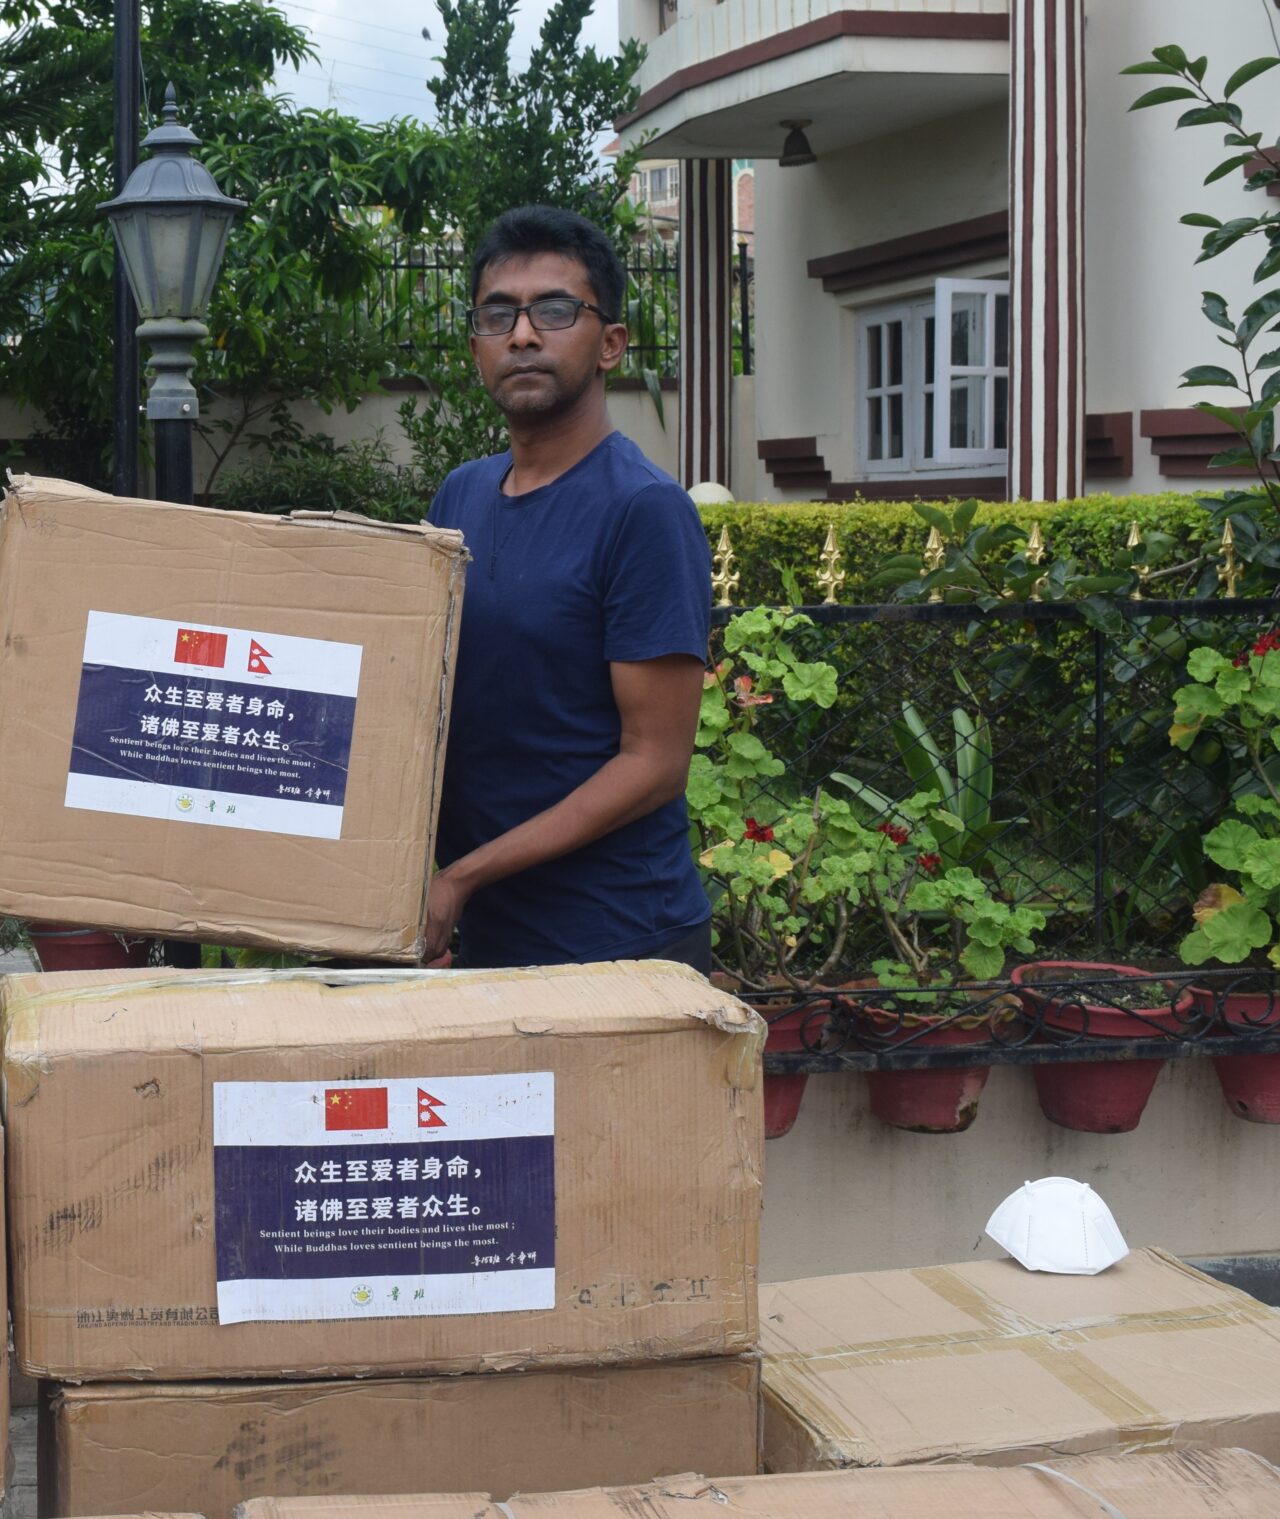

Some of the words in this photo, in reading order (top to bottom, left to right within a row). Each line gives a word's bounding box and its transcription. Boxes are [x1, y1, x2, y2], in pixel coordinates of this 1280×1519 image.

[144, 683, 294, 722] 众生至爱者身命，
[140, 714, 290, 751] 诸佛至爱者众生。
[109, 735, 143, 746] Sentient
[145, 740, 171, 751] beings
[173, 743, 189, 752] love
[191, 746, 211, 755] their
[212, 749, 238, 759] bodies
[240, 753, 255, 761] and
[257, 754, 276, 763] lives
[277, 757, 290, 765] the
[120, 749, 144, 759] While
[145, 753, 179, 763] Buddhas
[181, 757, 201, 767] loves
[203, 761, 235, 770] sentient
[237, 764, 263, 775] beings
[264, 768, 278, 776] the
[294, 1155, 482, 1184] 众生至爱者身命，
[294, 1193, 481, 1222] 诸佛至爱者众生。
[259, 1229, 300, 1238] Sentient
[303, 1229, 336, 1239] beings
[338, 1227, 358, 1237] love
[361, 1226, 385, 1236] their
[388, 1225, 420, 1235] bodies
[422, 1224, 440, 1234] and
[442, 1223, 466, 1233] lives
[468, 1222, 484, 1231] the
[274, 1244, 303, 1253] While
[306, 1243, 347, 1252] Buddhas
[350, 1242, 375, 1251] loves
[377, 1240, 417, 1250] sentient
[420, 1239, 452, 1249] beings
[454, 1239, 470, 1247] the
[472, 1237, 499, 1246] most.
